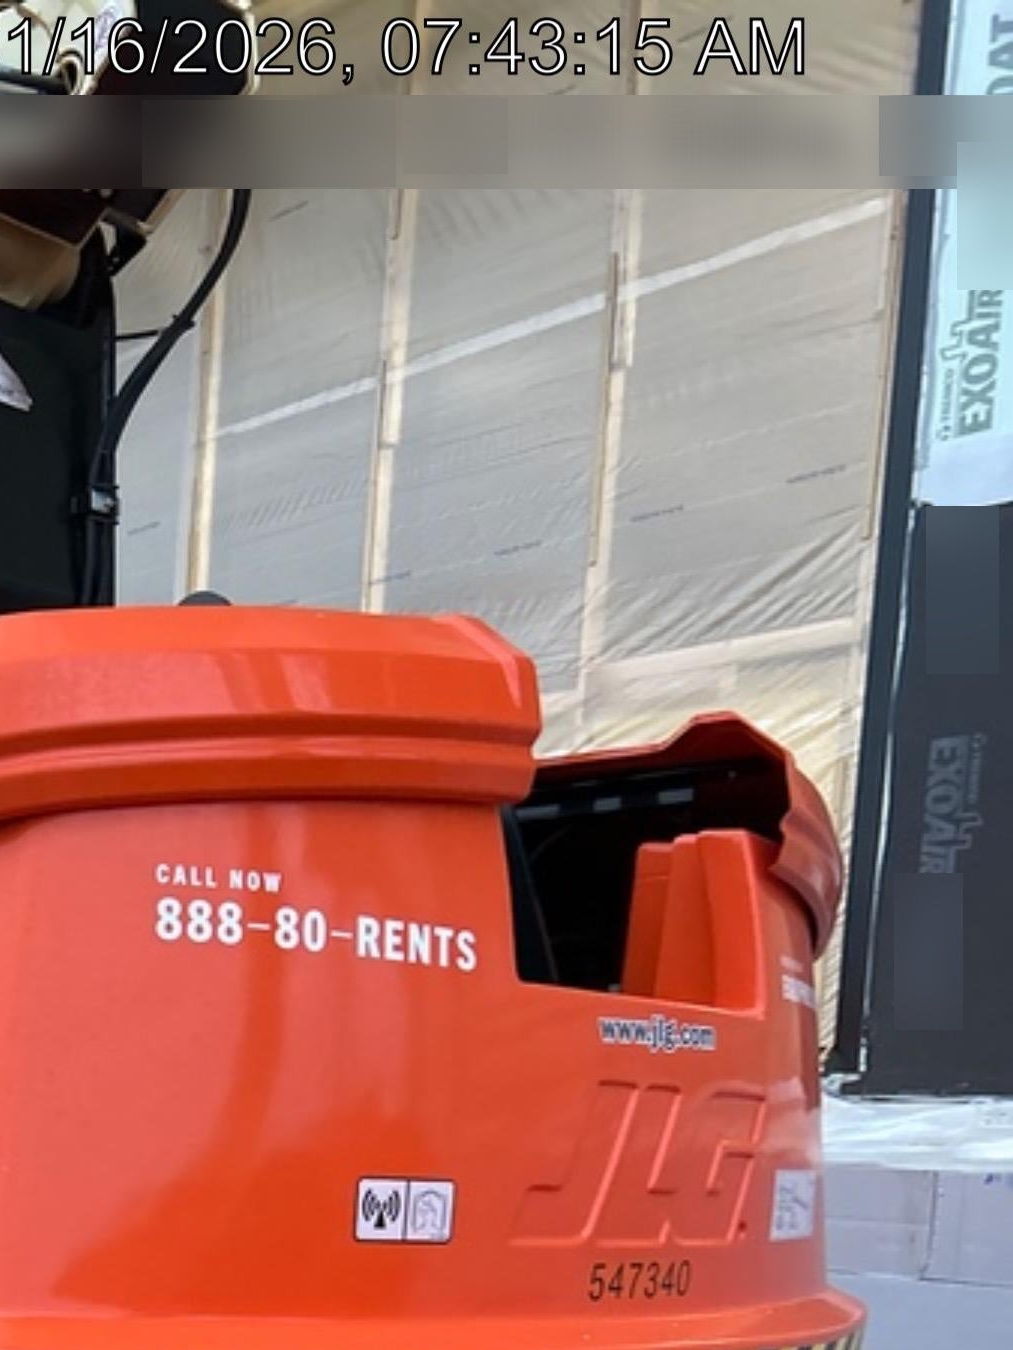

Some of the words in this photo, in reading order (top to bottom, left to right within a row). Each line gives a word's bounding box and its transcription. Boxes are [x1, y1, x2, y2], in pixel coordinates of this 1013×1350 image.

[155, 863, 217, 888] CALL
[229, 869, 282, 892] NOW
[155, 897, 477, 971] 888-80-RENTS
[598, 1015, 716, 1052] www.jlg.com
[508, 1079, 766, 1245] JLG
[588, 1259, 691, 1302] 547340
